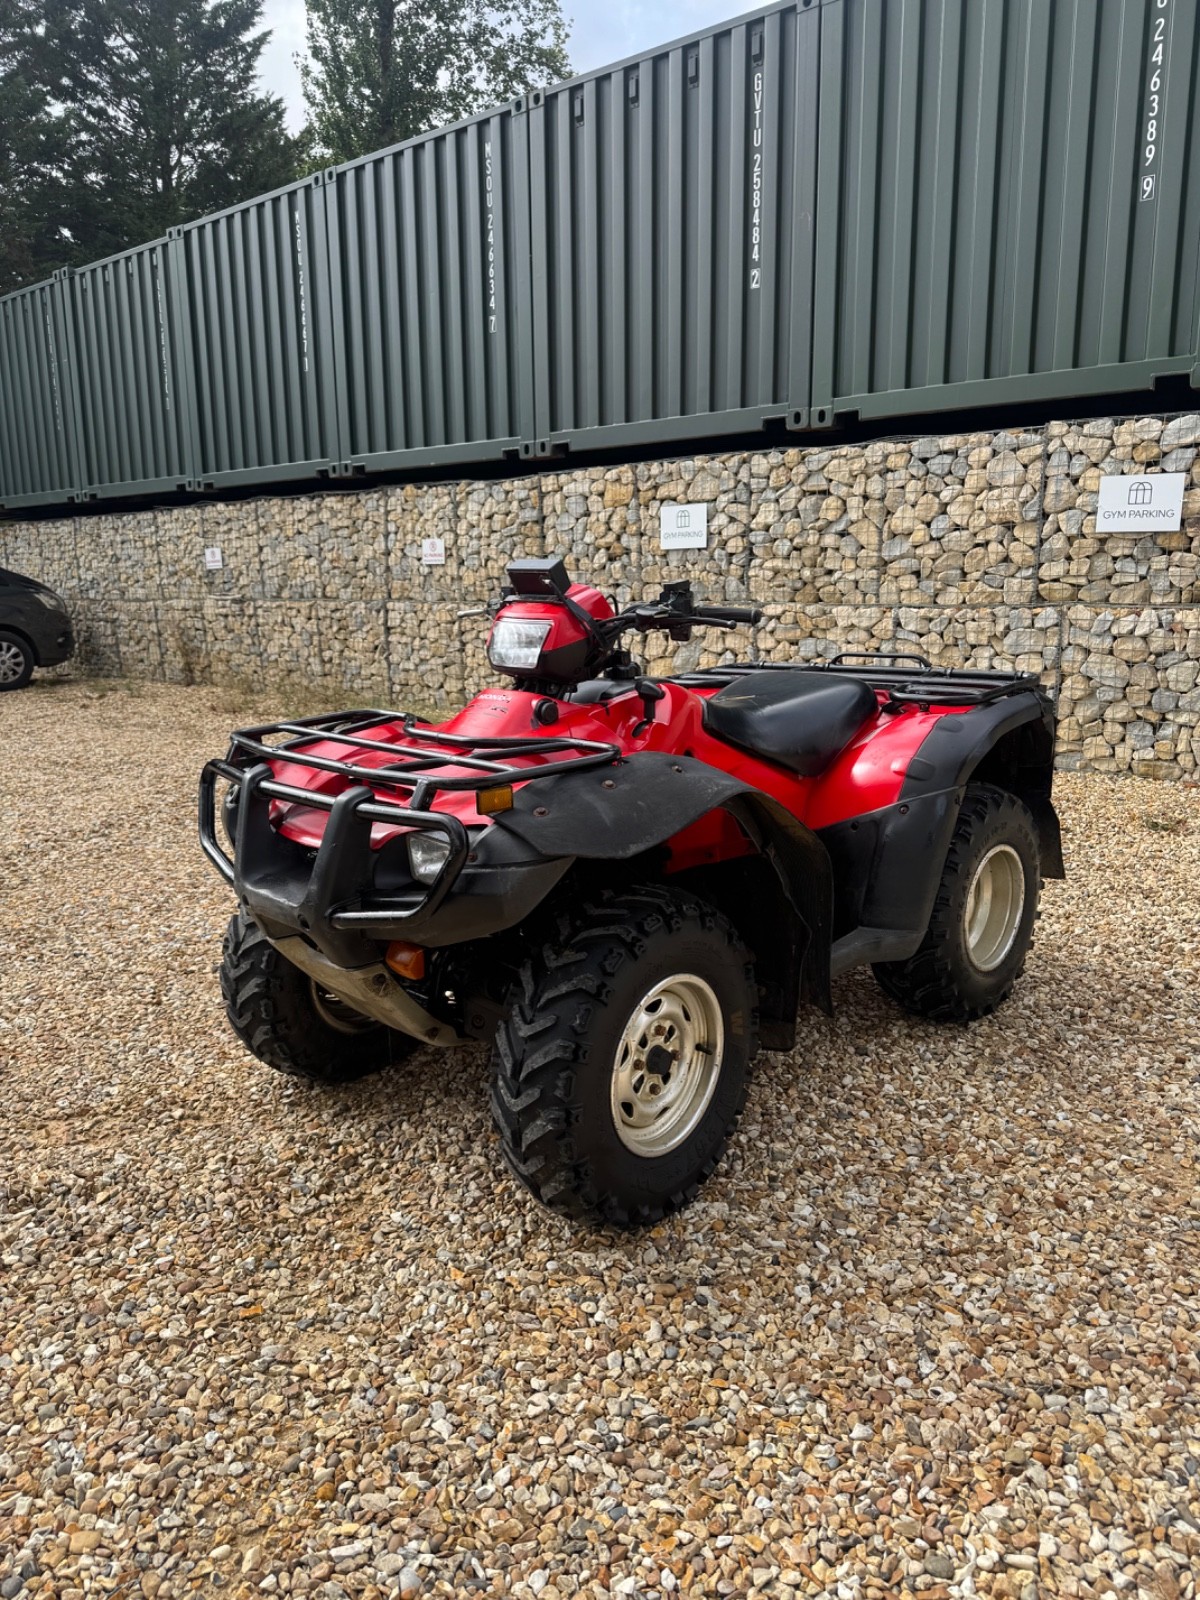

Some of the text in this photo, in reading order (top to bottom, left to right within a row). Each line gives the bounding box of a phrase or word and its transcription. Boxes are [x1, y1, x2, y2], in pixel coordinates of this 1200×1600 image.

[1145, 18, 1165, 167] 246389
[484, 142, 493, 208] MSOU
[750, 72, 762, 289] GVTU 258484 2
[1141, 176, 1155, 200] 9
[487, 214, 496, 310] 246634
[663, 530, 703, 540] GYM PARKING
[1103, 509, 1175, 520] GYM PARKING
